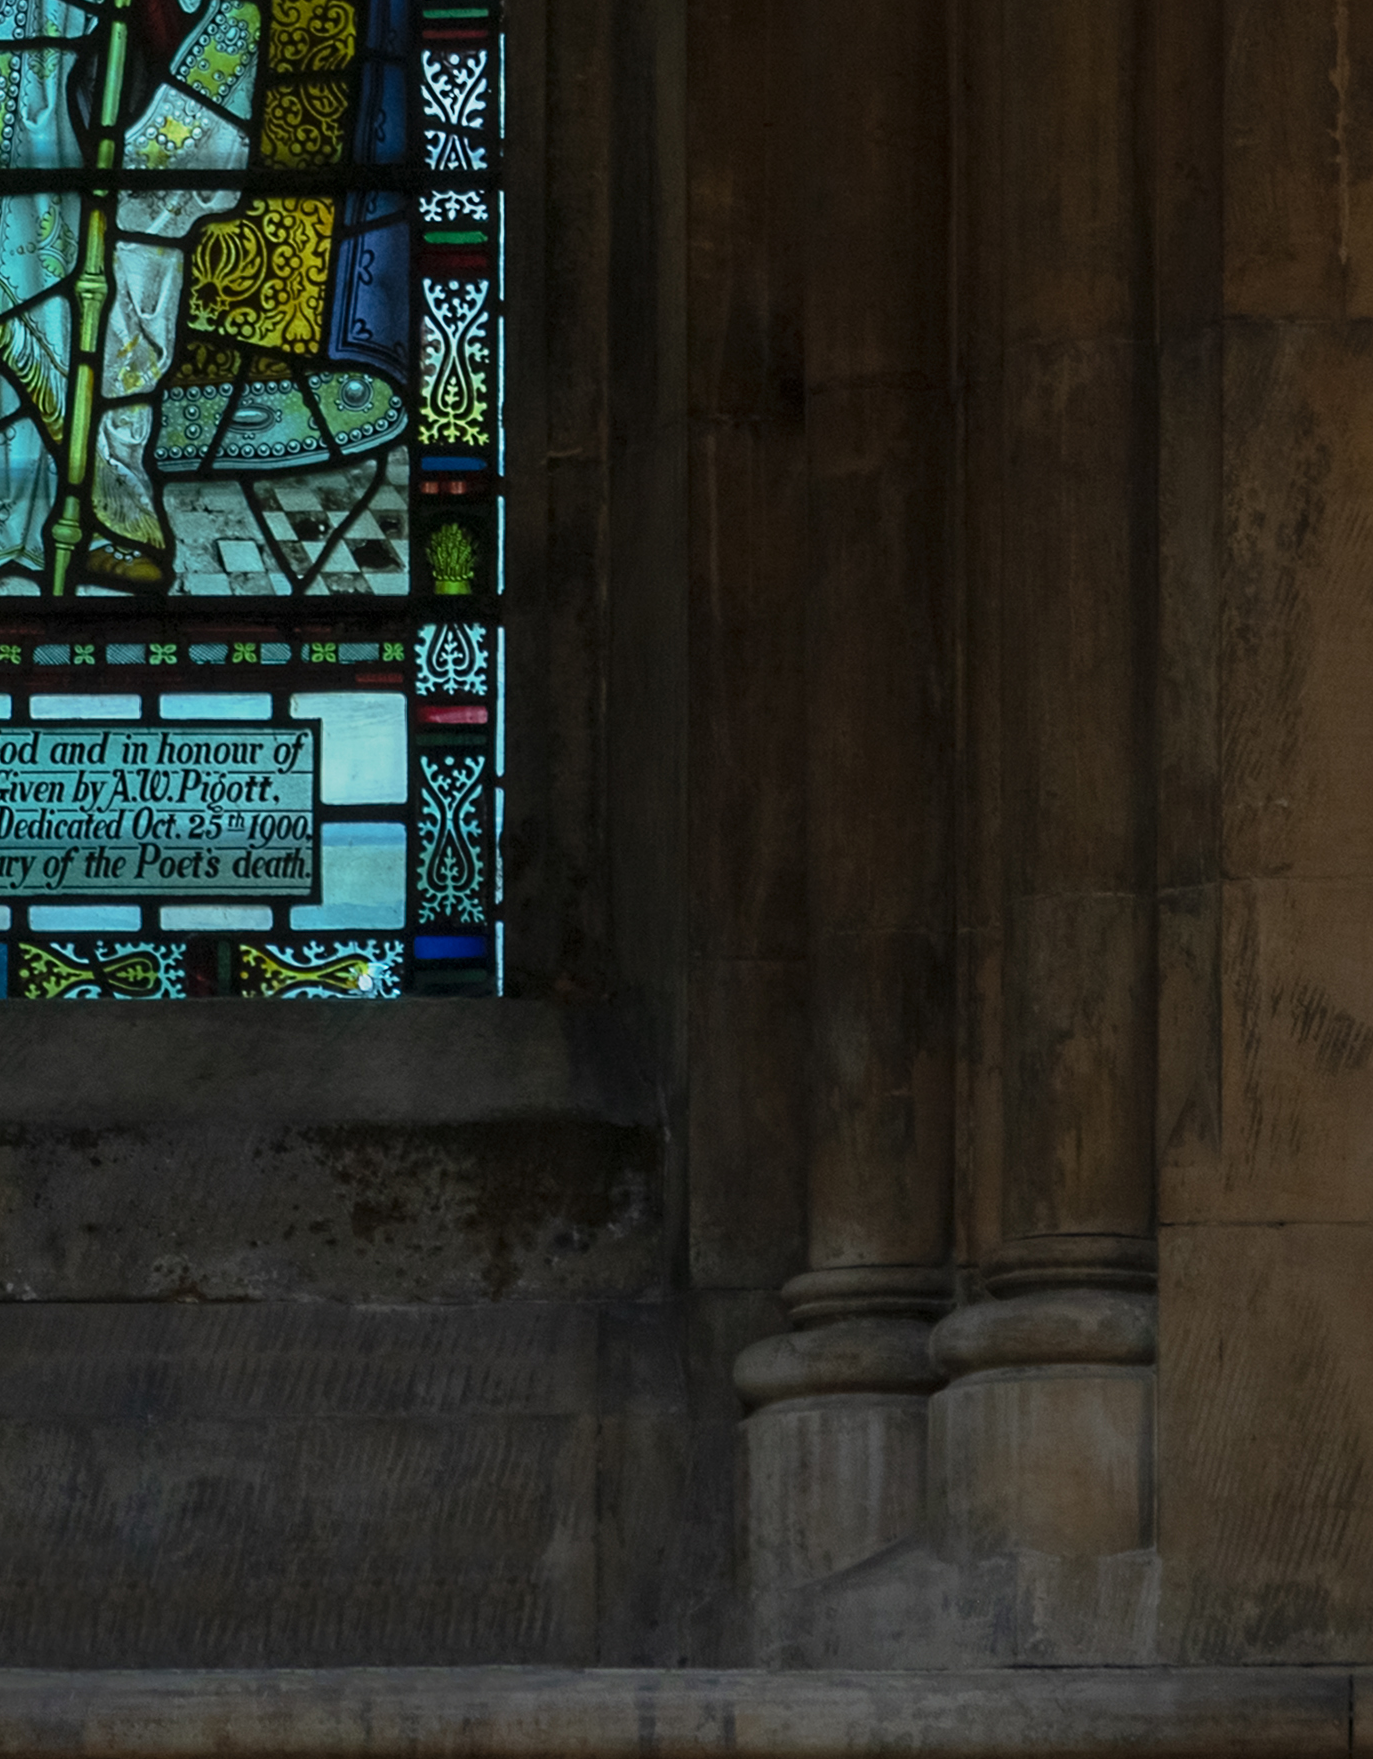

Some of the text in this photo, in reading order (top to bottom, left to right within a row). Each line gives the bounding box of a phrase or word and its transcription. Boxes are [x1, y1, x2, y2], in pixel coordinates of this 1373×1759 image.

[50, 731, 110, 765] and
[122, 734, 154, 765] in
[156, 732, 264, 765] honour
[273, 733, 309, 773] of
[72, 770, 107, 812] by
[132, 807, 181, 839] Oct.
[43, 846, 79, 890] of
[85, 846, 127, 878] the
[232, 846, 311, 878] death.
